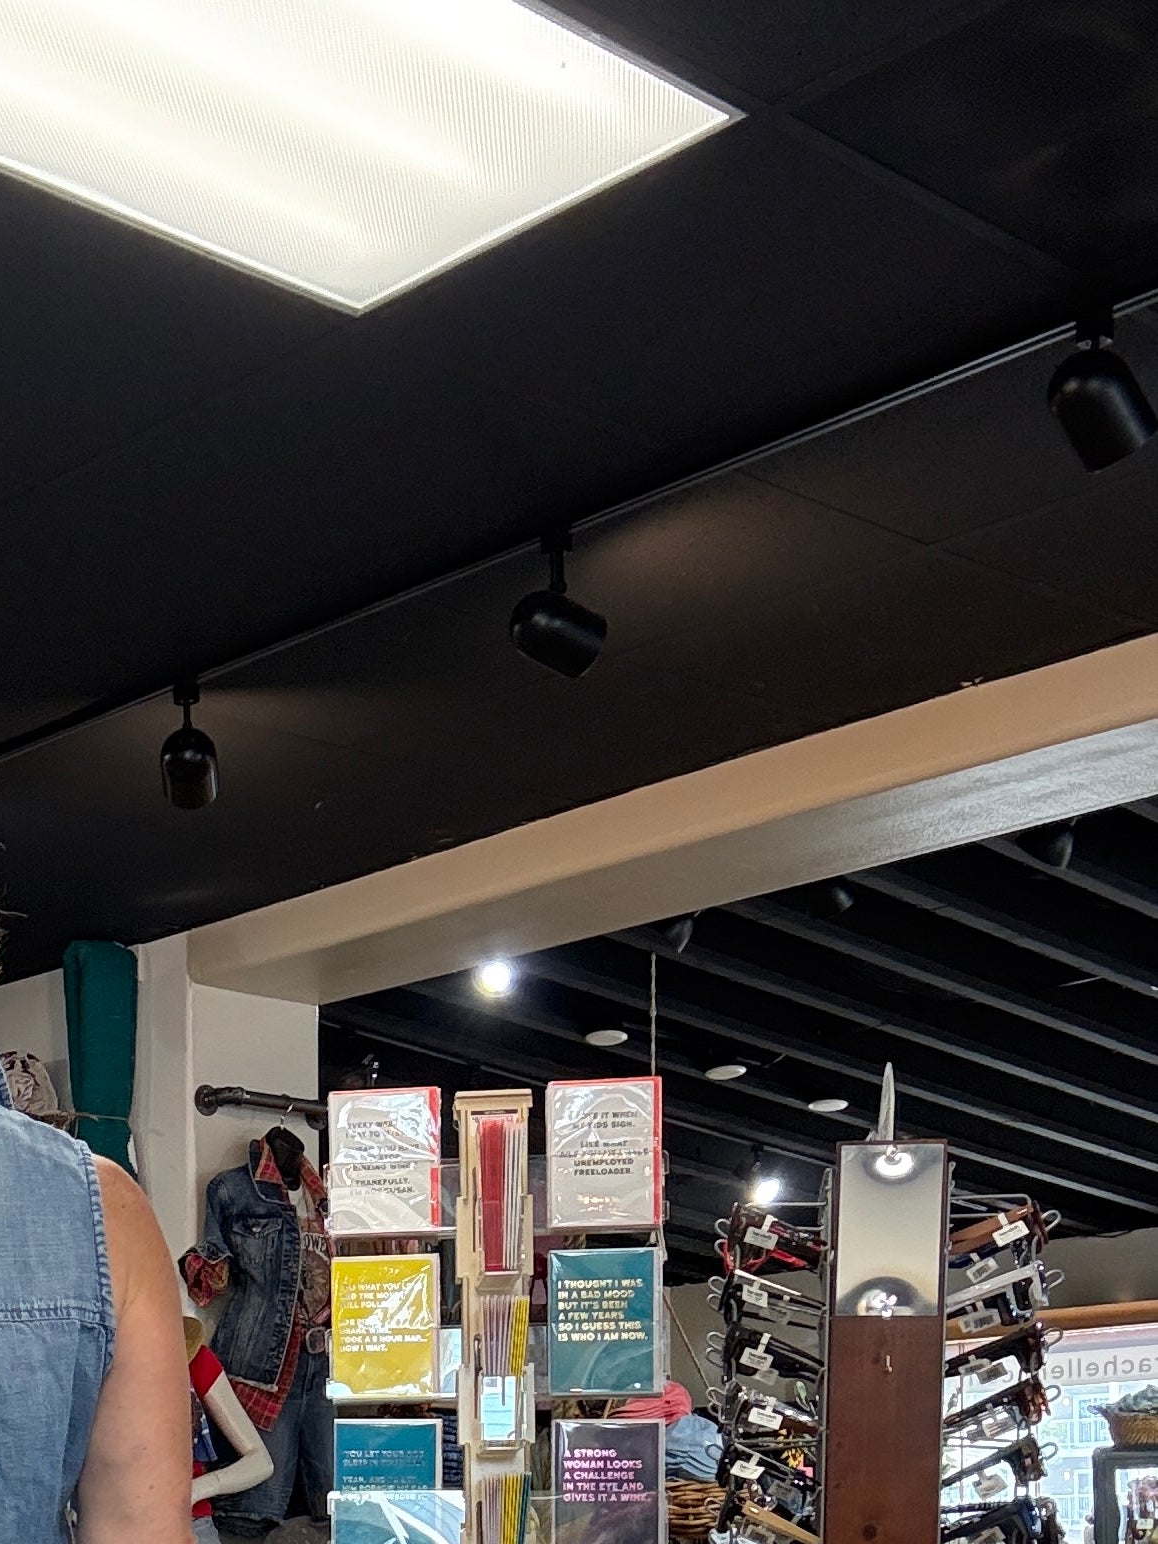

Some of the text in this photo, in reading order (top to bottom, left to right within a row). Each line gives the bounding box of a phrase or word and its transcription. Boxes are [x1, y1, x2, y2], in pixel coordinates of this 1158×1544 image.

[563, 1279, 613, 1289] THOUGHT
[621, 1278, 643, 1287] WAS
[557, 1289, 635, 1300] IN A BAD MOOD
[557, 1301, 579, 1310] BUT
[580, 1301, 600, 1310] IT'S
[558, 1310, 625, 1320] A FEW YEARS
[558, 1322, 574, 1331] SO
[581, 1321, 617, 1331] GUESS
[618, 1320, 642, 1330] THIS
[557, 1332, 569, 1342] IS
[570, 1332, 596, 1342] WHO
[603, 1332, 620, 1341] AM
[620, 1331, 649, 1341] NOW.
[563, 1448, 618, 1458] A STRONG
[563, 1459, 643, 1469] WOMAN LOOKS
[563, 1470, 635, 1480] A CHALLENGE
[562, 1481, 645, 1491] IN THE EYE AND
[562, 1492, 596, 1502] GIVES
[597, 1493, 608, 1502] IT
[609, 1492, 619, 1502] A
